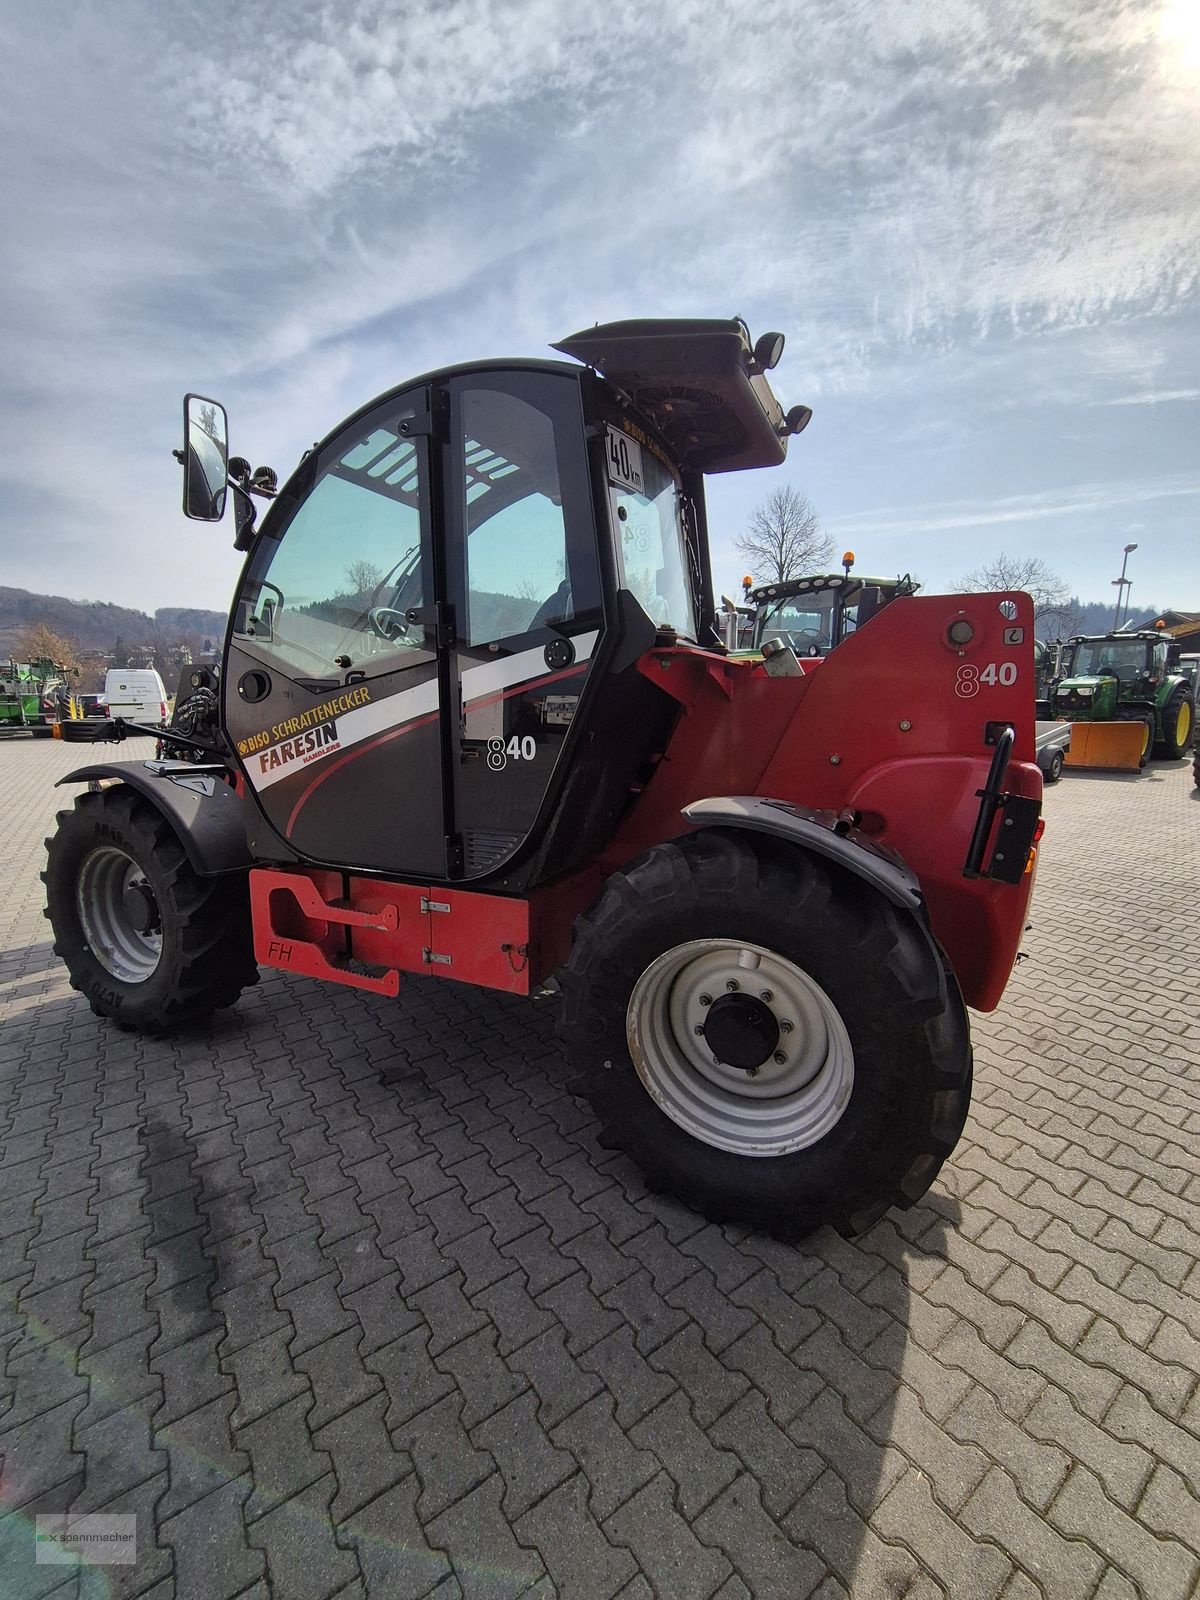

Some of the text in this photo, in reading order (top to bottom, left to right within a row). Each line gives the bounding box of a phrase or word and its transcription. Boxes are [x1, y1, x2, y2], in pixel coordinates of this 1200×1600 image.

[609, 432, 642, 488] 40 km
[954, 662, 1018, 699] 840
[247, 686, 371, 752] BISO SCHRATTENECKER
[258, 720, 338, 774] FARESIN
[303, 742, 342, 763] HANDLERS
[486, 735, 537, 772] 840
[267, 940, 294, 962] FH
